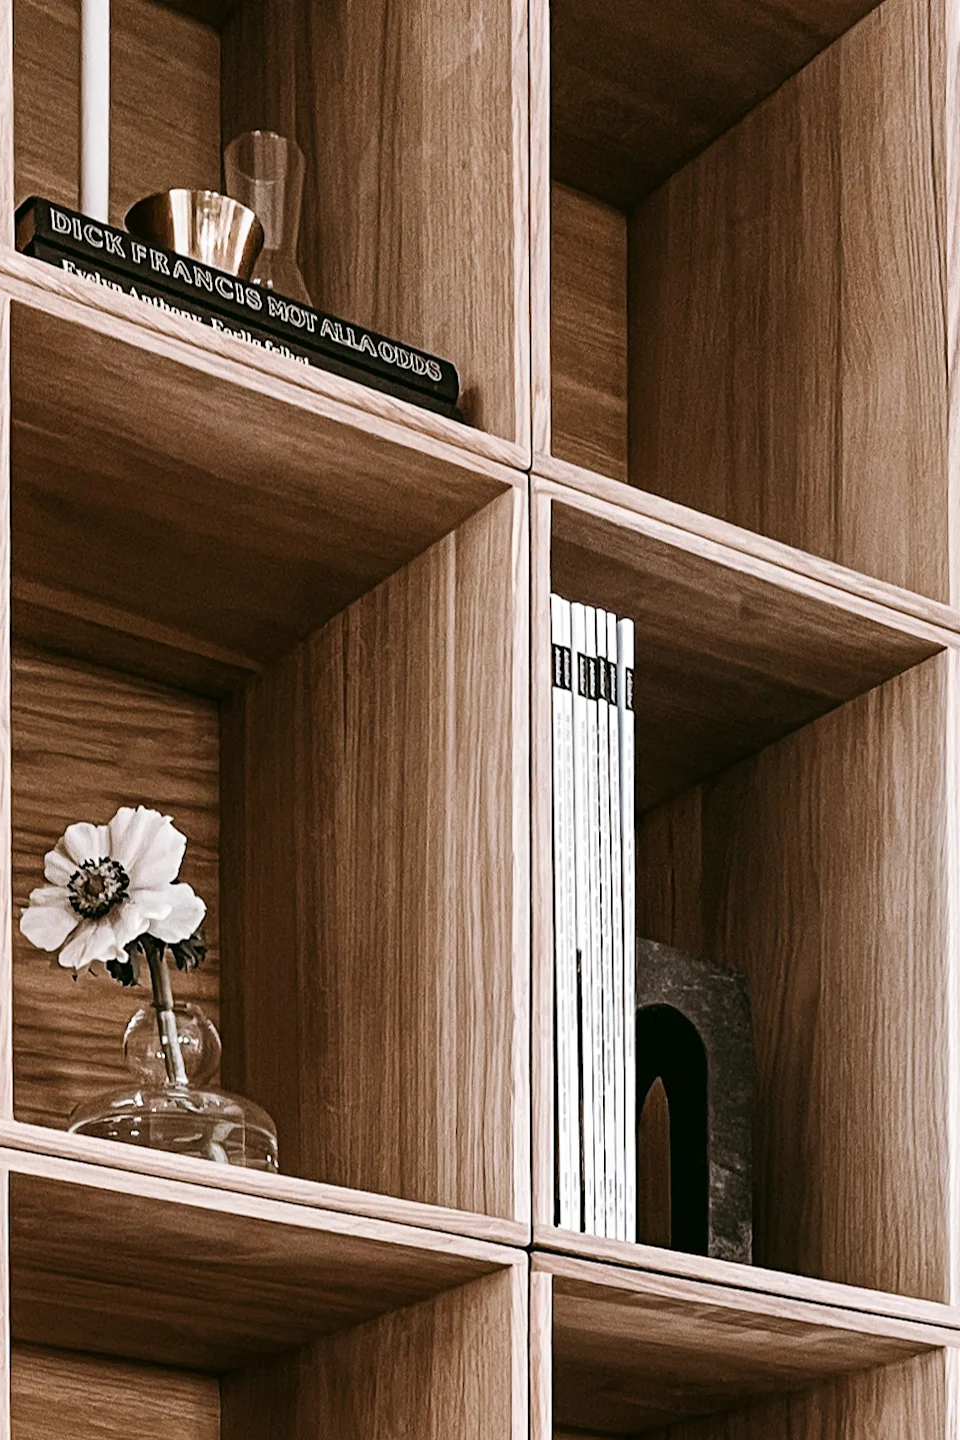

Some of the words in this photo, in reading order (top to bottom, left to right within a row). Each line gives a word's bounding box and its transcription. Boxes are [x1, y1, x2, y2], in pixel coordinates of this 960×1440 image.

[50, 207, 126, 258] DICK
[131, 241, 263, 311] FRANCIS
[267, 296, 318, 333] MOT
[320, 319, 378, 358] ALLA
[378, 341, 442, 381] ODDS
